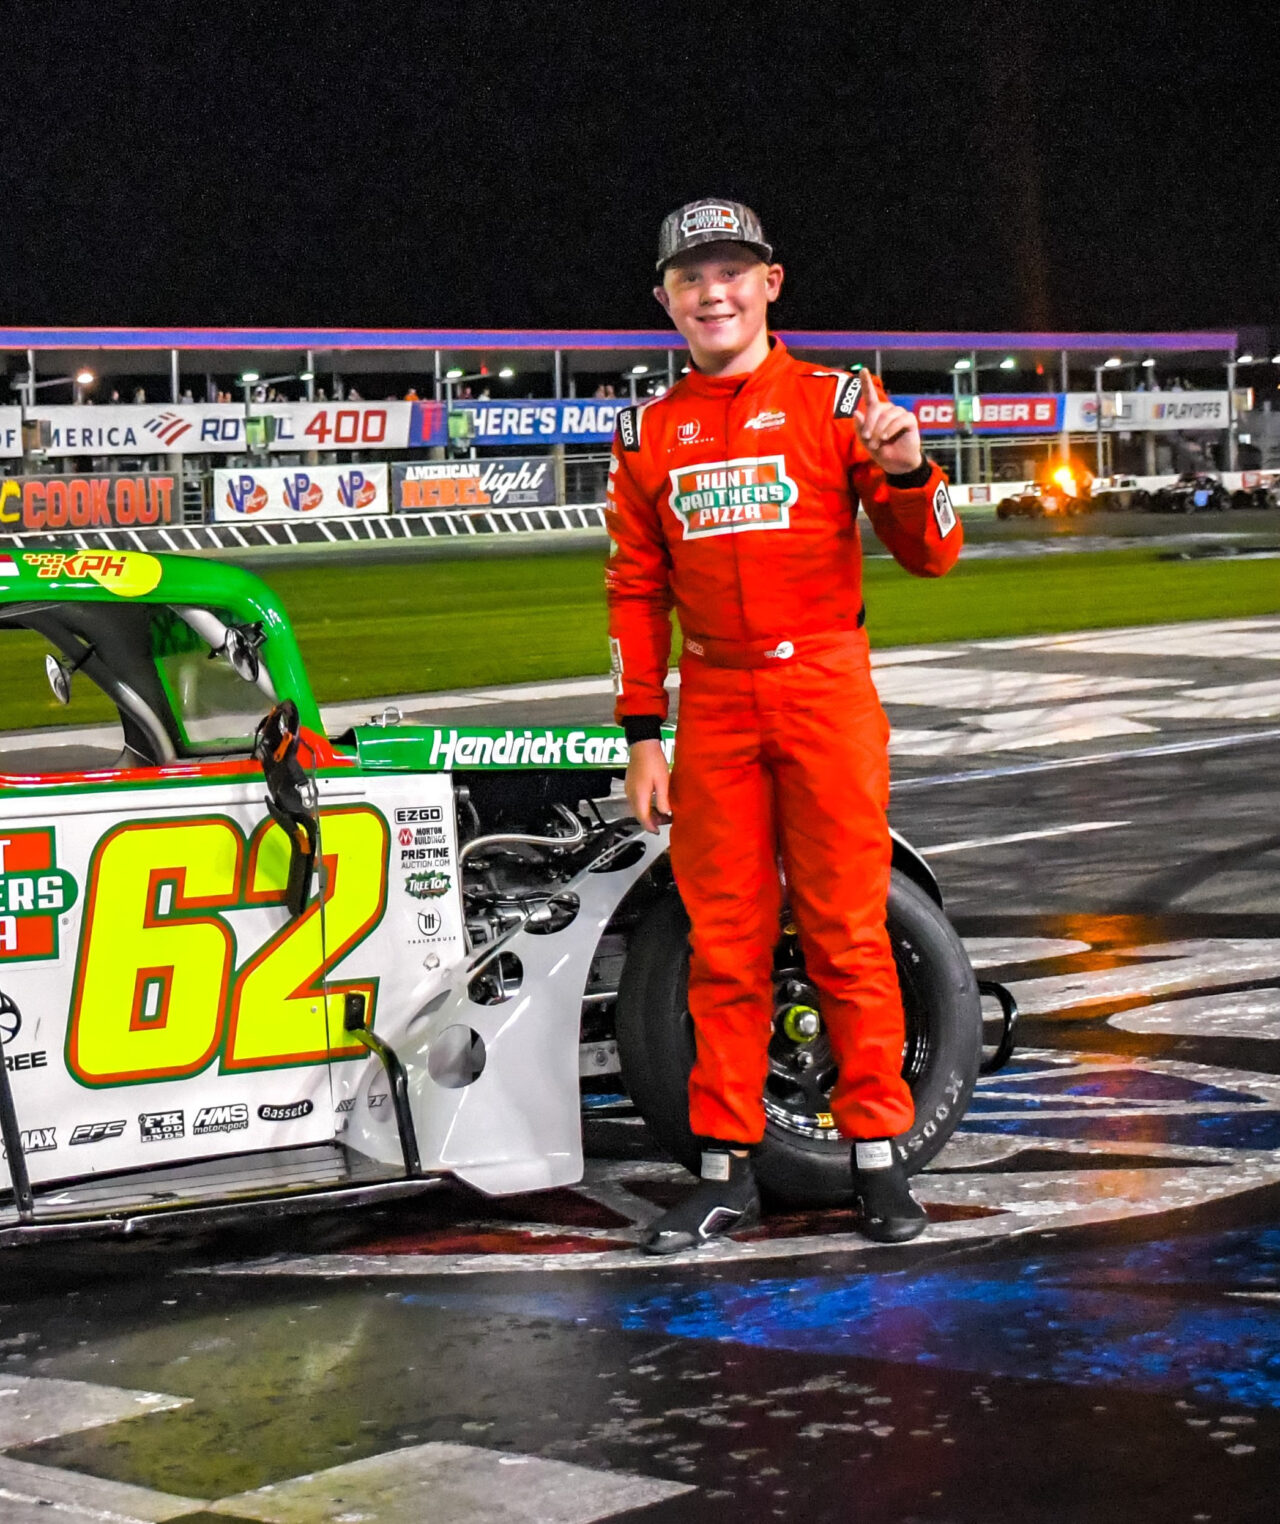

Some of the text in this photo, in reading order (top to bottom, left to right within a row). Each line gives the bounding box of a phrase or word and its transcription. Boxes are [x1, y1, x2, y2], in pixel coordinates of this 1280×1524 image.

[561, 405, 619, 434] RAC
[920, 403, 1051, 422] OCBER 5
[51, 427, 138, 448] MERICA
[200, 417, 295, 442] ROL
[304, 409, 387, 444] 400
[620, 410, 634, 447] sparco
[338, 470, 365, 508] VP
[405, 464, 480, 480] AMERICAN
[479, 462, 547, 503] light
[695, 468, 755, 490] HUNT
[23, 477, 174, 528] COOK OUT
[228, 475, 255, 513] VP
[283, 473, 310, 511] VP
[401, 478, 491, 508] REBEL
[699, 504, 761, 525] PIZZA
[401, 847, 449, 860] PRISTINE
[70, 808, 388, 1080] 62
[193, 1104, 248, 1125] HMS
[261, 1101, 308, 1118] Bassett
[141, 1132, 184, 1142] ENDS
[151, 1125, 183, 1134] ROD
[194, 1120, 248, 1134] motorsport
[20, 1128, 56, 1149] MAX
